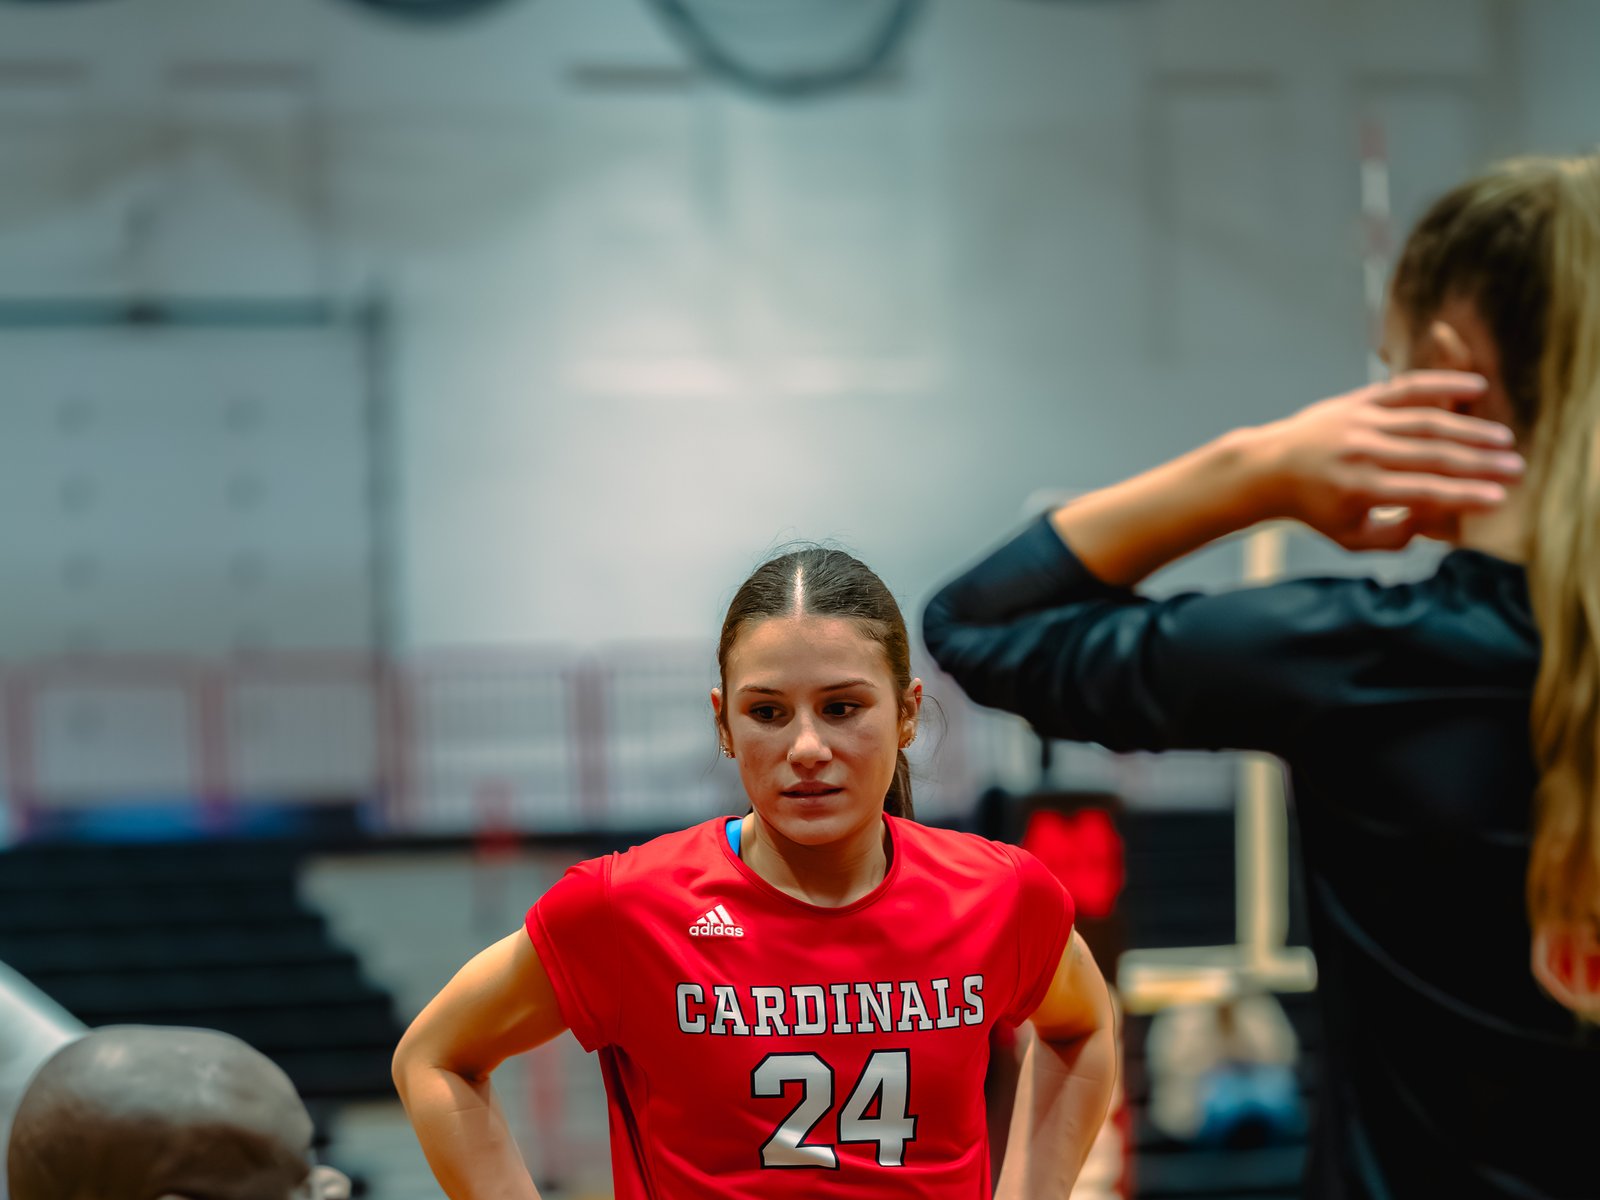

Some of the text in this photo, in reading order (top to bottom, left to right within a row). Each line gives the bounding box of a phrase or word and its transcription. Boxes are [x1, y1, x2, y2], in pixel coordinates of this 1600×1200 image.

[688, 921, 744, 937] adidas
[676, 974, 985, 1036] CARDINALS
[751, 1048, 918, 1171] 24
